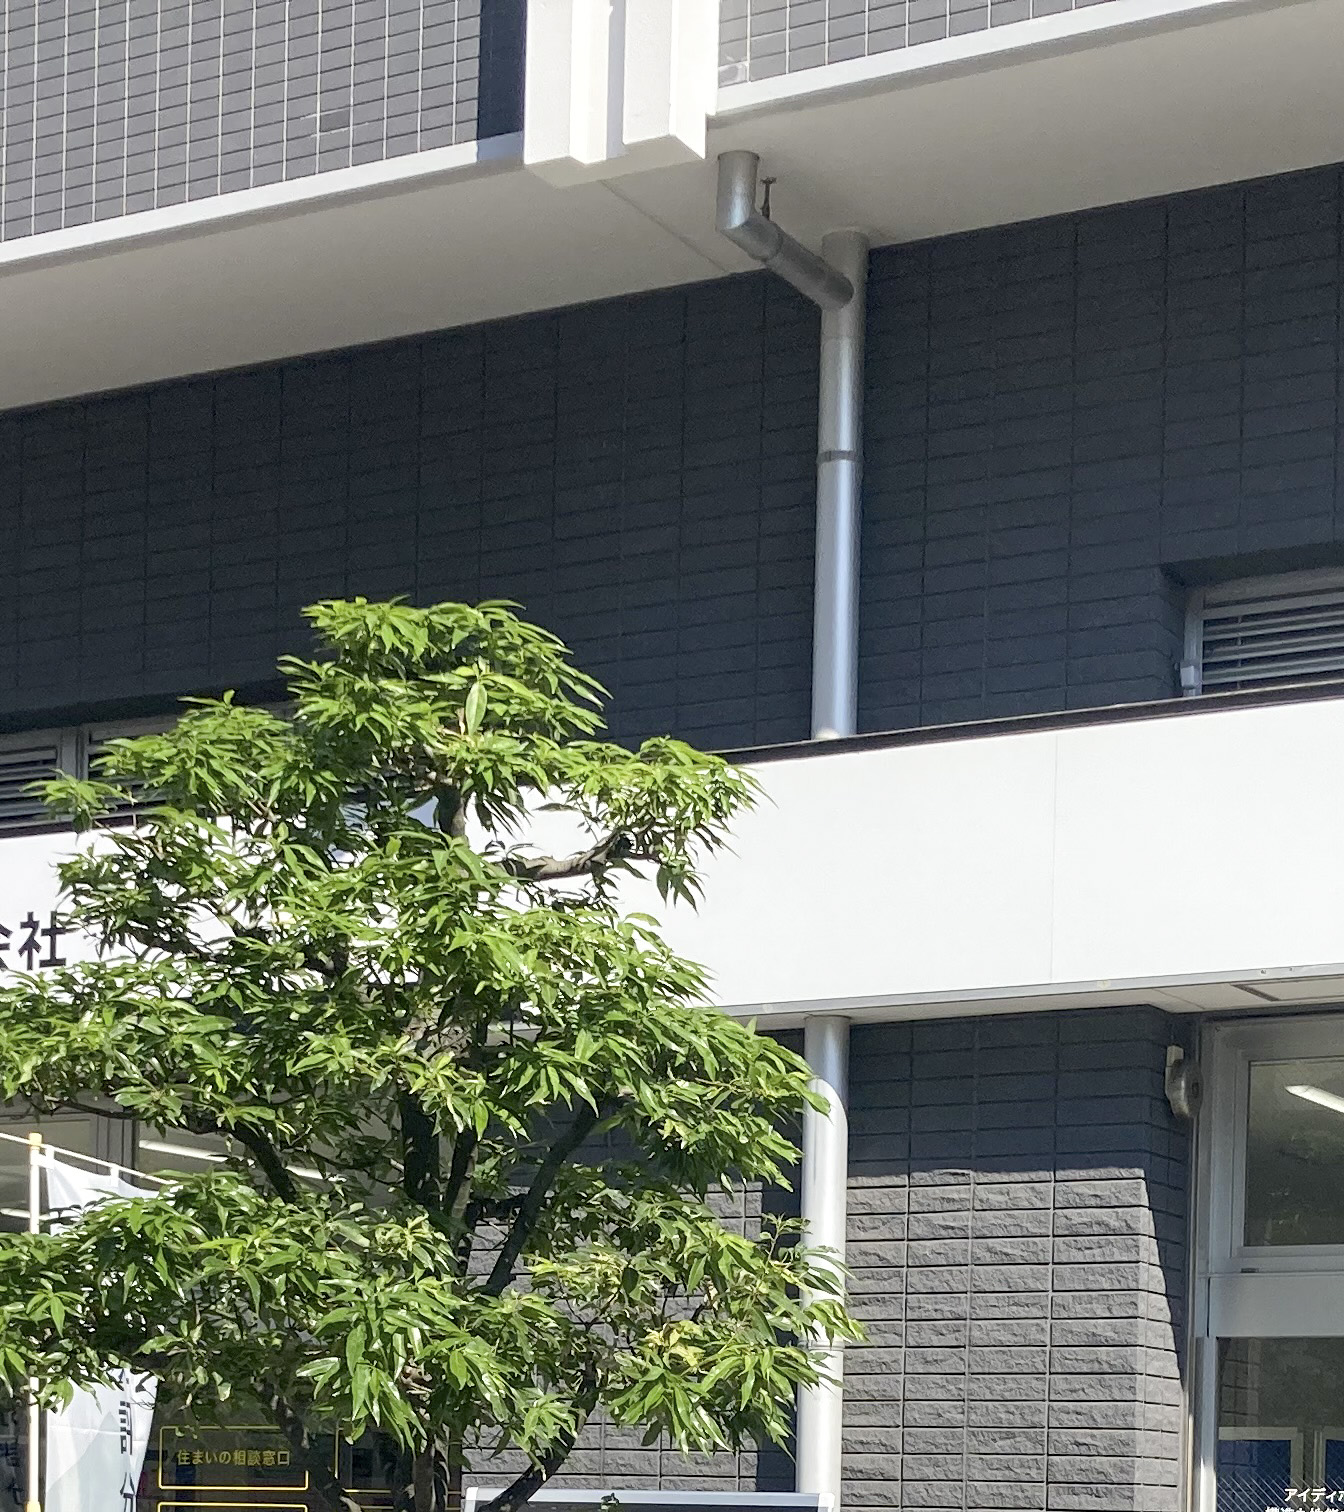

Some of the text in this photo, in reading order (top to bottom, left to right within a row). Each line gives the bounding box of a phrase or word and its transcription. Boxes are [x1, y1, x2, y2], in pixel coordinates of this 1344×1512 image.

[177, 1449, 291, 1467] 住まいの相談窓口
